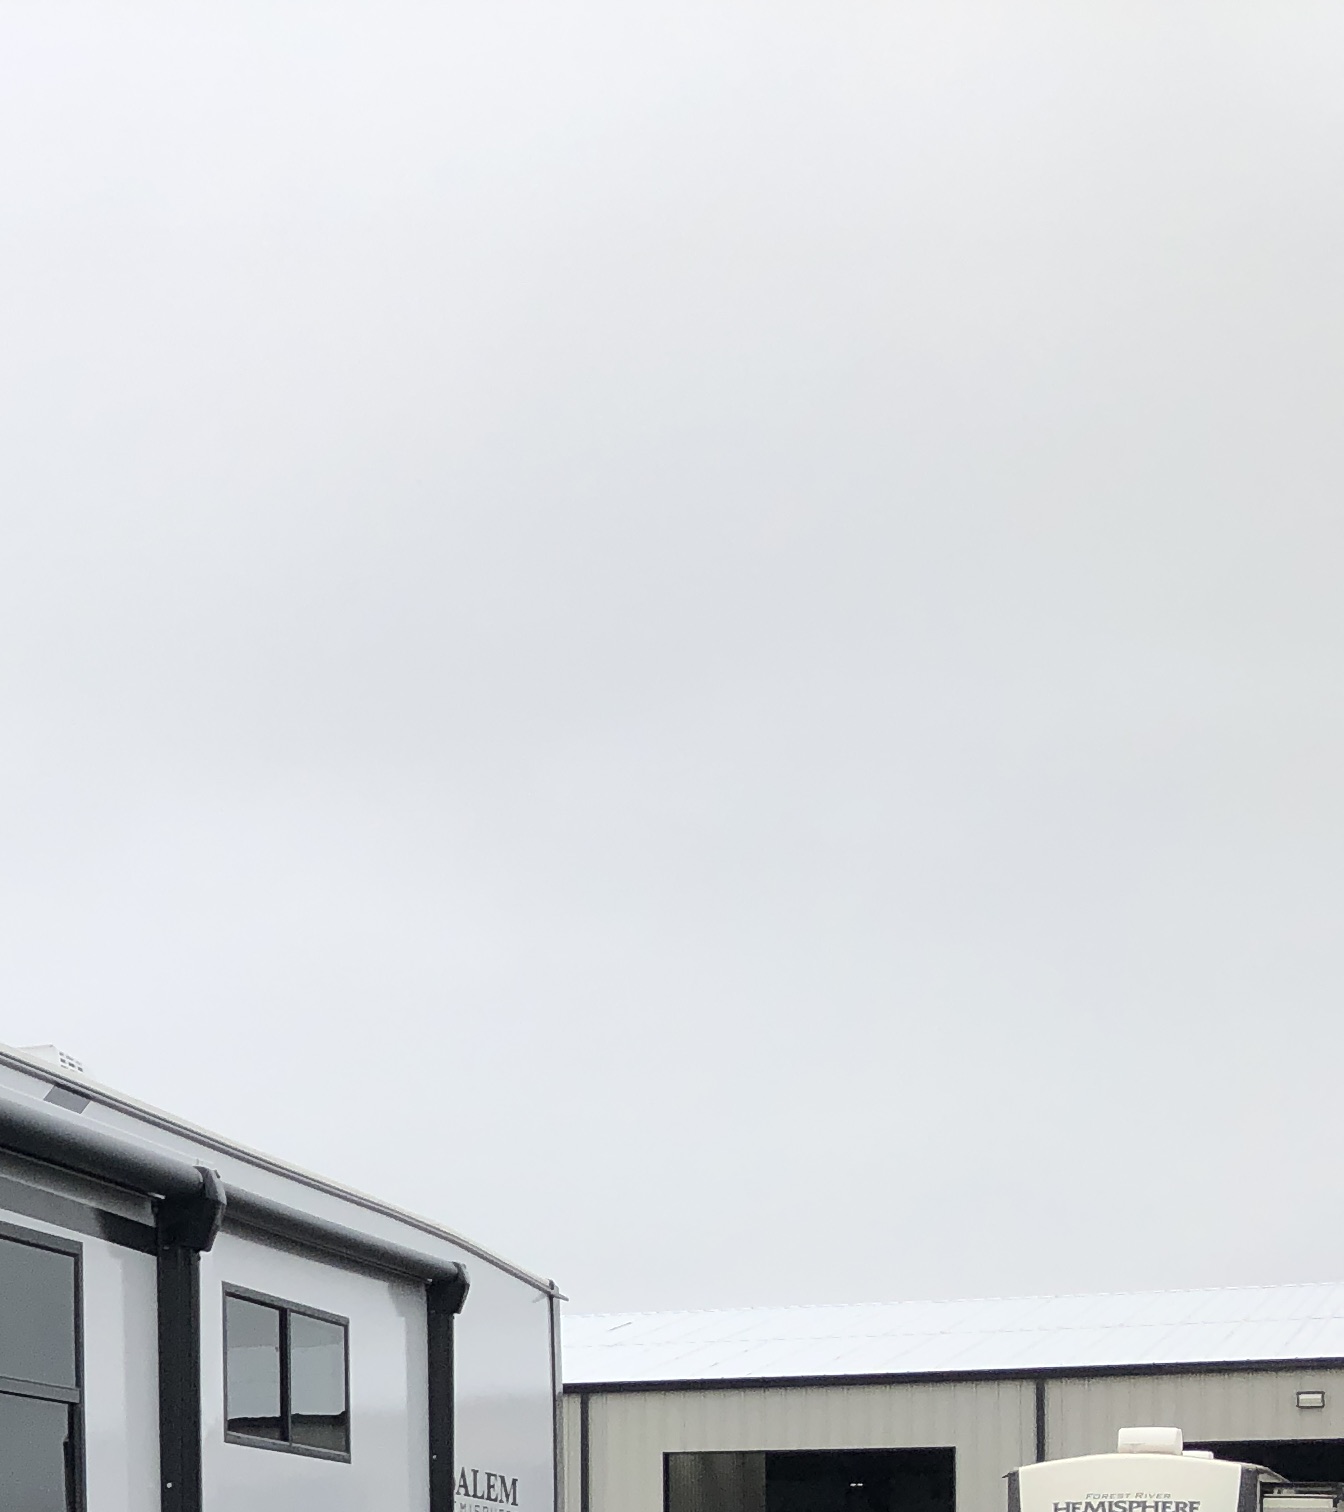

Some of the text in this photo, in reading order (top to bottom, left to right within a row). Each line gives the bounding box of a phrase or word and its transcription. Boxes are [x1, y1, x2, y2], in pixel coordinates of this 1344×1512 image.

[452, 1466, 519, 1507] ALEM
[1085, 1491, 1172, 1500] FOREST RIVER
